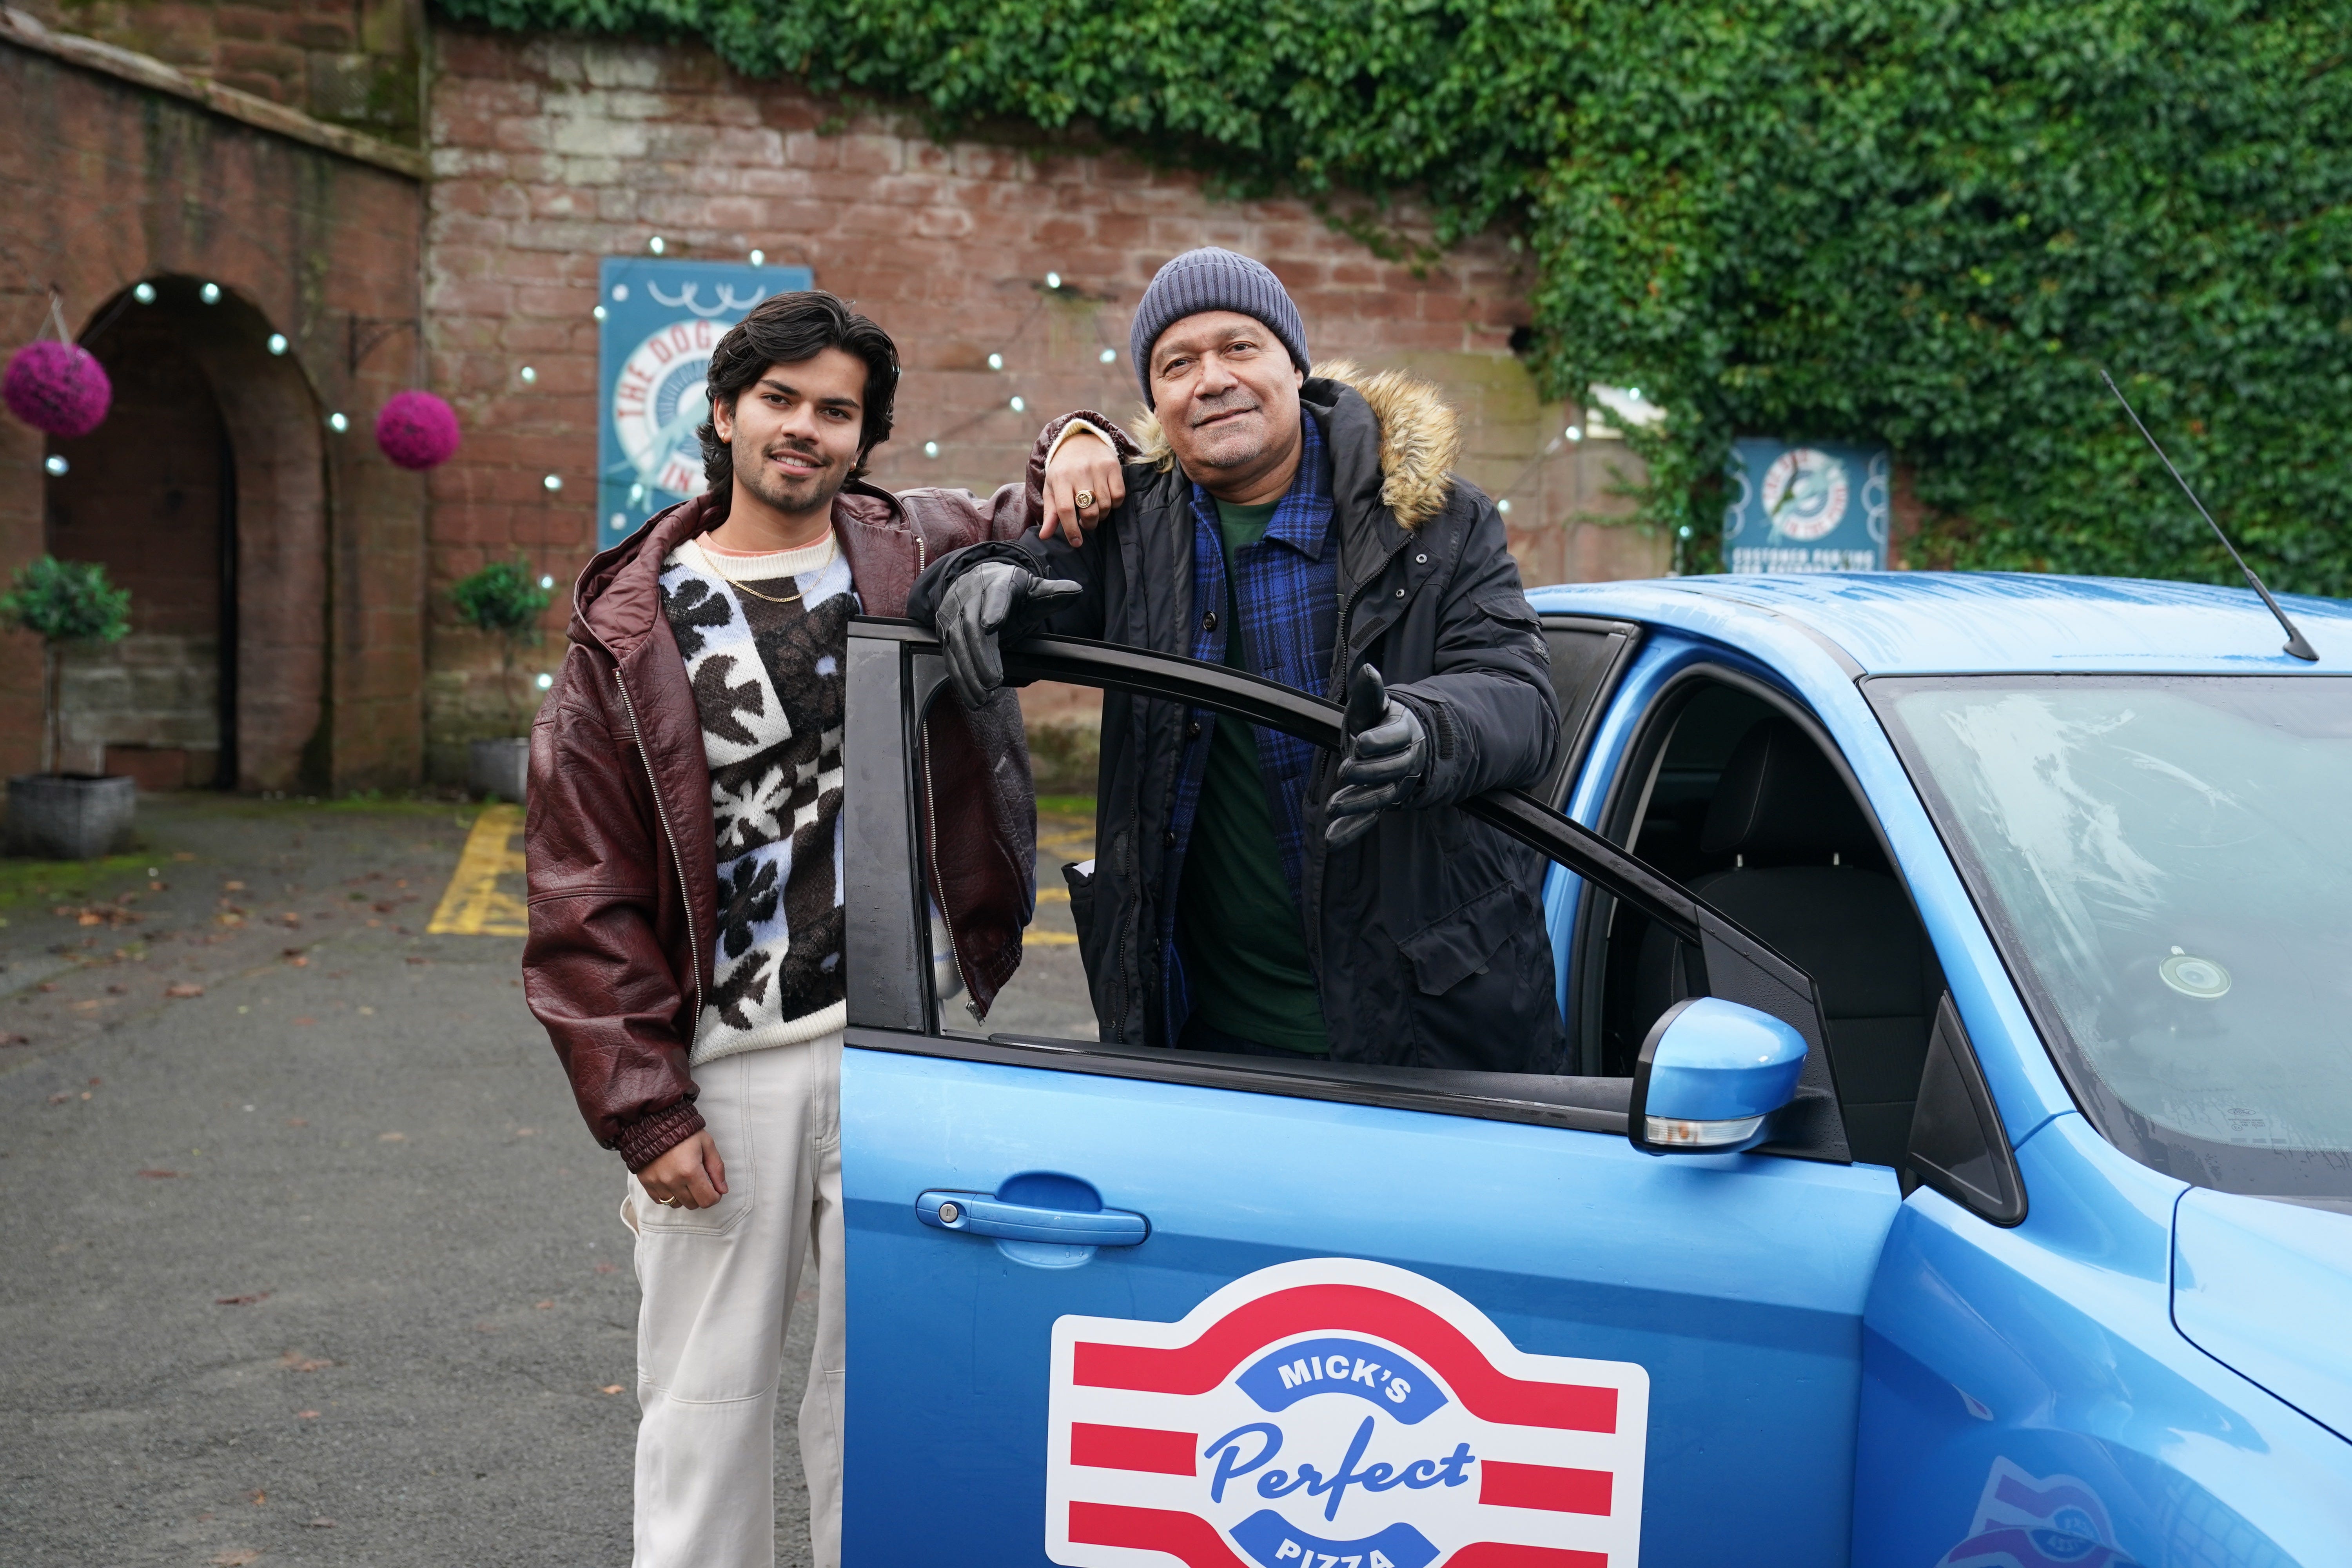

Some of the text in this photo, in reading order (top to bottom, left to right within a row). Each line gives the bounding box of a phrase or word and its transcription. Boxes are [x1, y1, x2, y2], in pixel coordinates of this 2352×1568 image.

[617, 319, 711, 418] THE DOG
[662, 463, 693, 492] IN
[1278, 1355, 1411, 1403] MICK'S
[1204, 1415, 1475, 1522] Perfect
[1274, 1538, 1395, 1568] PIZZA
